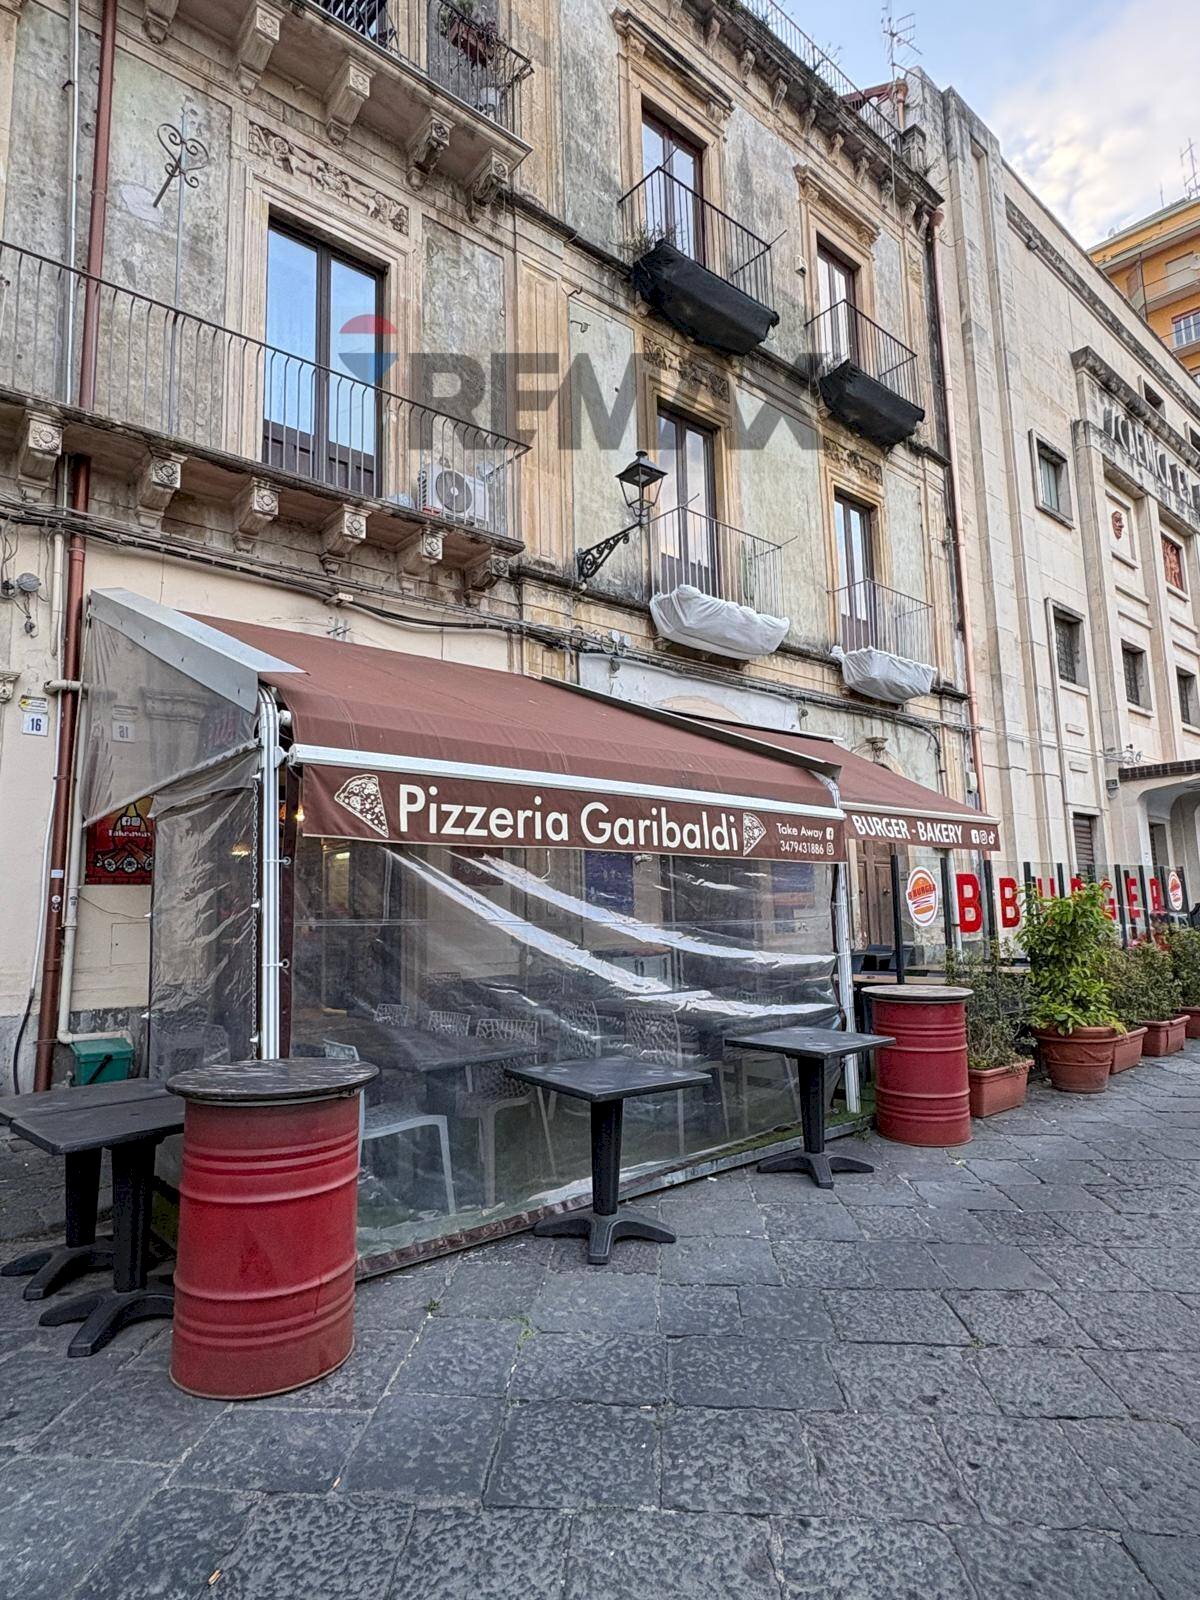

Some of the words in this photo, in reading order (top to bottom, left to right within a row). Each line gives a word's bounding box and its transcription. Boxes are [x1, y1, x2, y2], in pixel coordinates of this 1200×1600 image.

[30, 717, 42, 732] 16
[399, 784, 568, 842] Pizzeria
[580, 802, 738, 851] Garibaldi
[851, 814, 911, 839] BURGER
[917, 822, 963, 844] BAKERY
[776, 822, 798, 836] Take
[800, 825, 824, 841] Away
[780, 840, 825, 855] 3479431886
[955, 873, 984, 933] B
